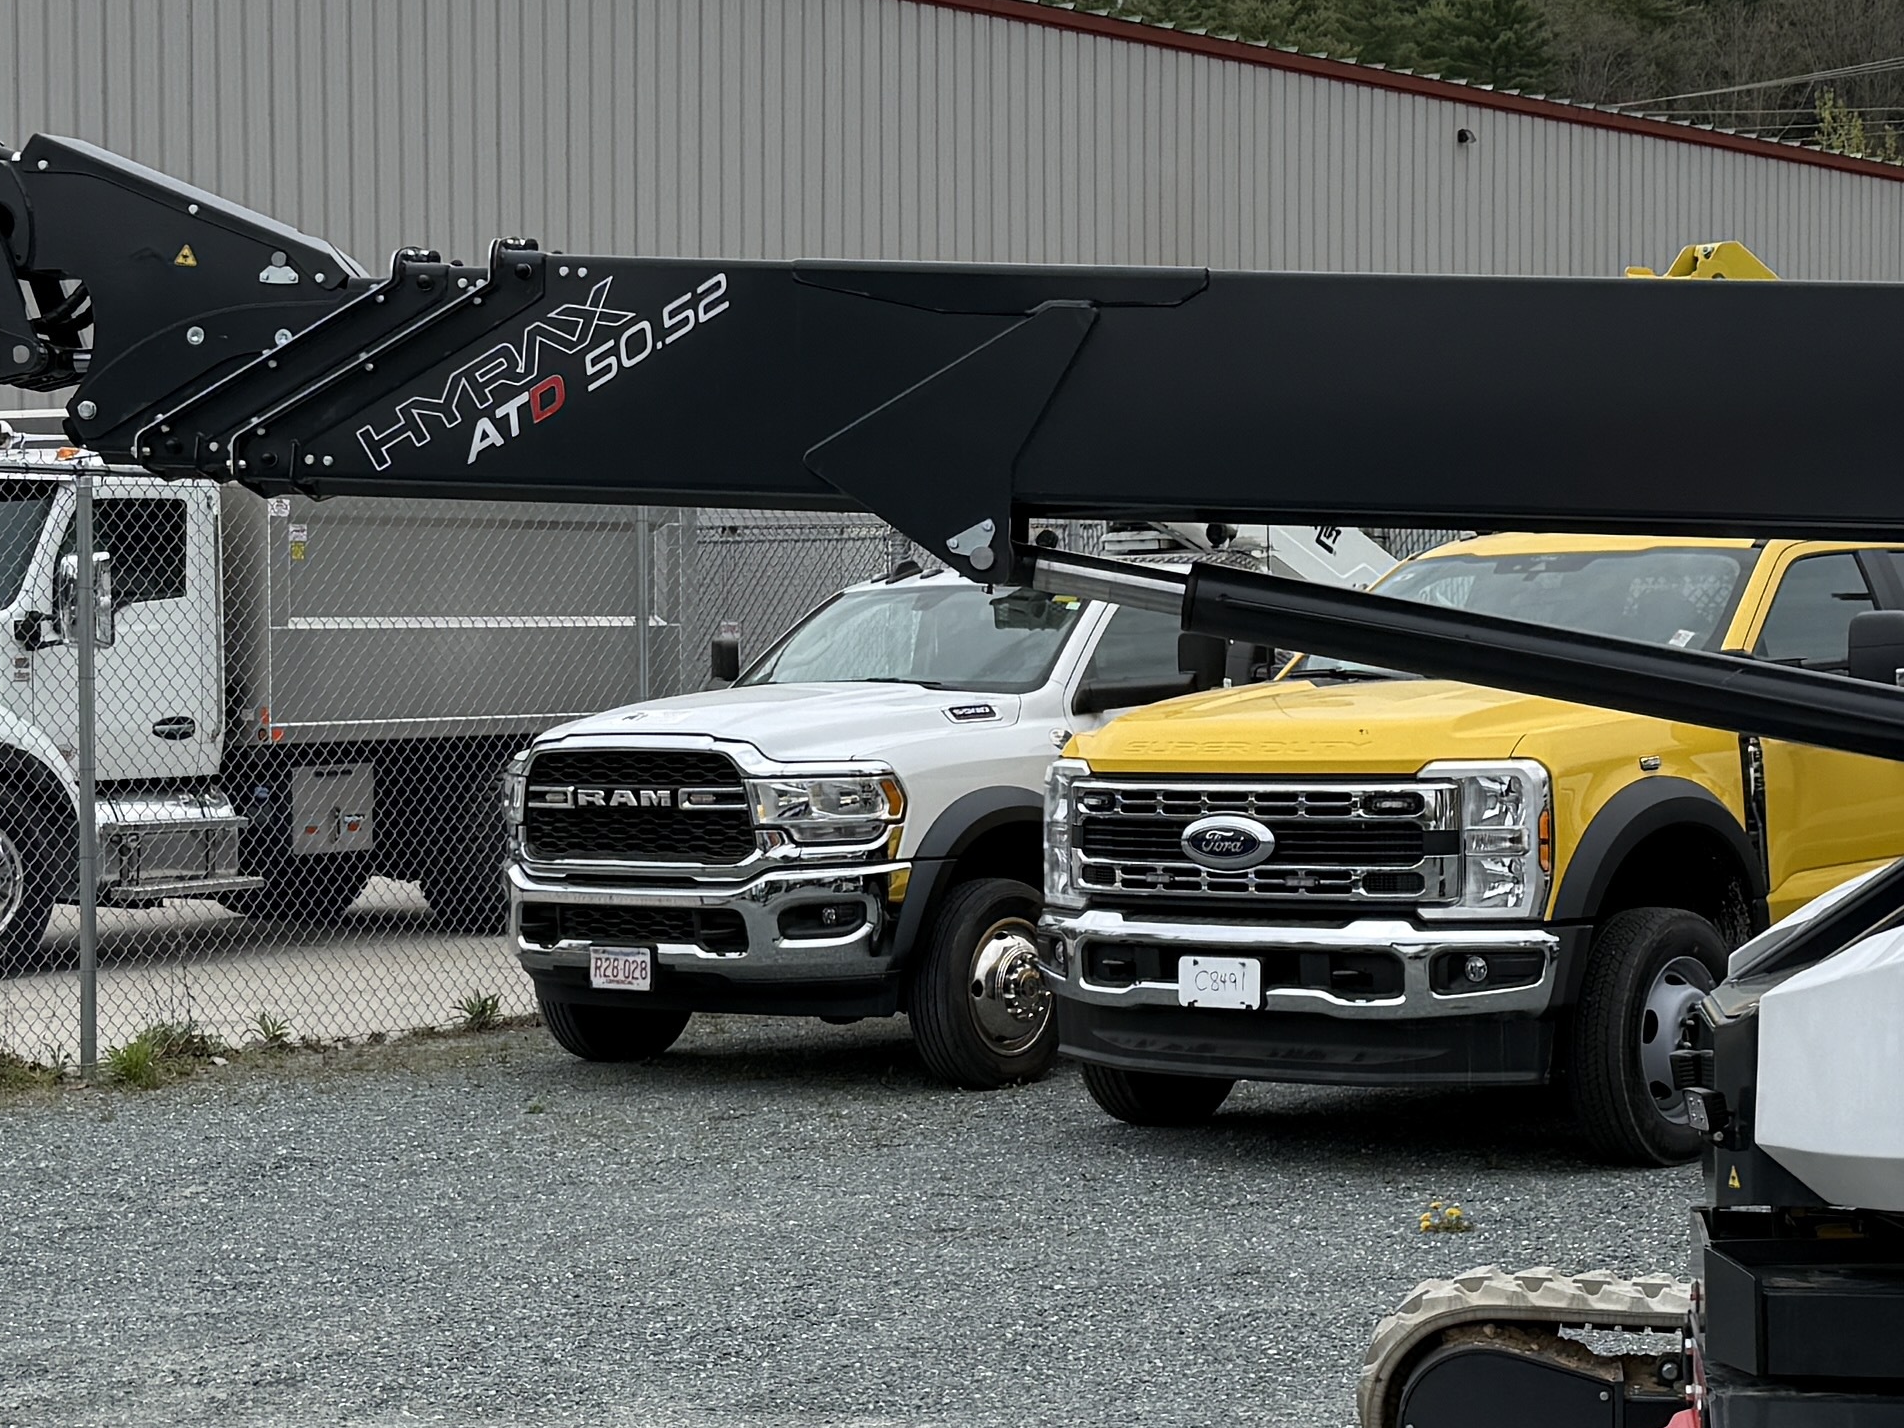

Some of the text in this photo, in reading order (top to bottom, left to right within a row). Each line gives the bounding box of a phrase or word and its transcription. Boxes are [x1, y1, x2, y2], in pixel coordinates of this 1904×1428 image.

[585, 273, 730, 392] 50.52
[356, 276, 636, 471] HYRAX
[1123, 740, 1374, 755] SUPER DUTY
[577, 789, 672, 807] RAM
[1201, 830, 1245, 853] Ford
[1194, 970, 1245, 991] C8491
